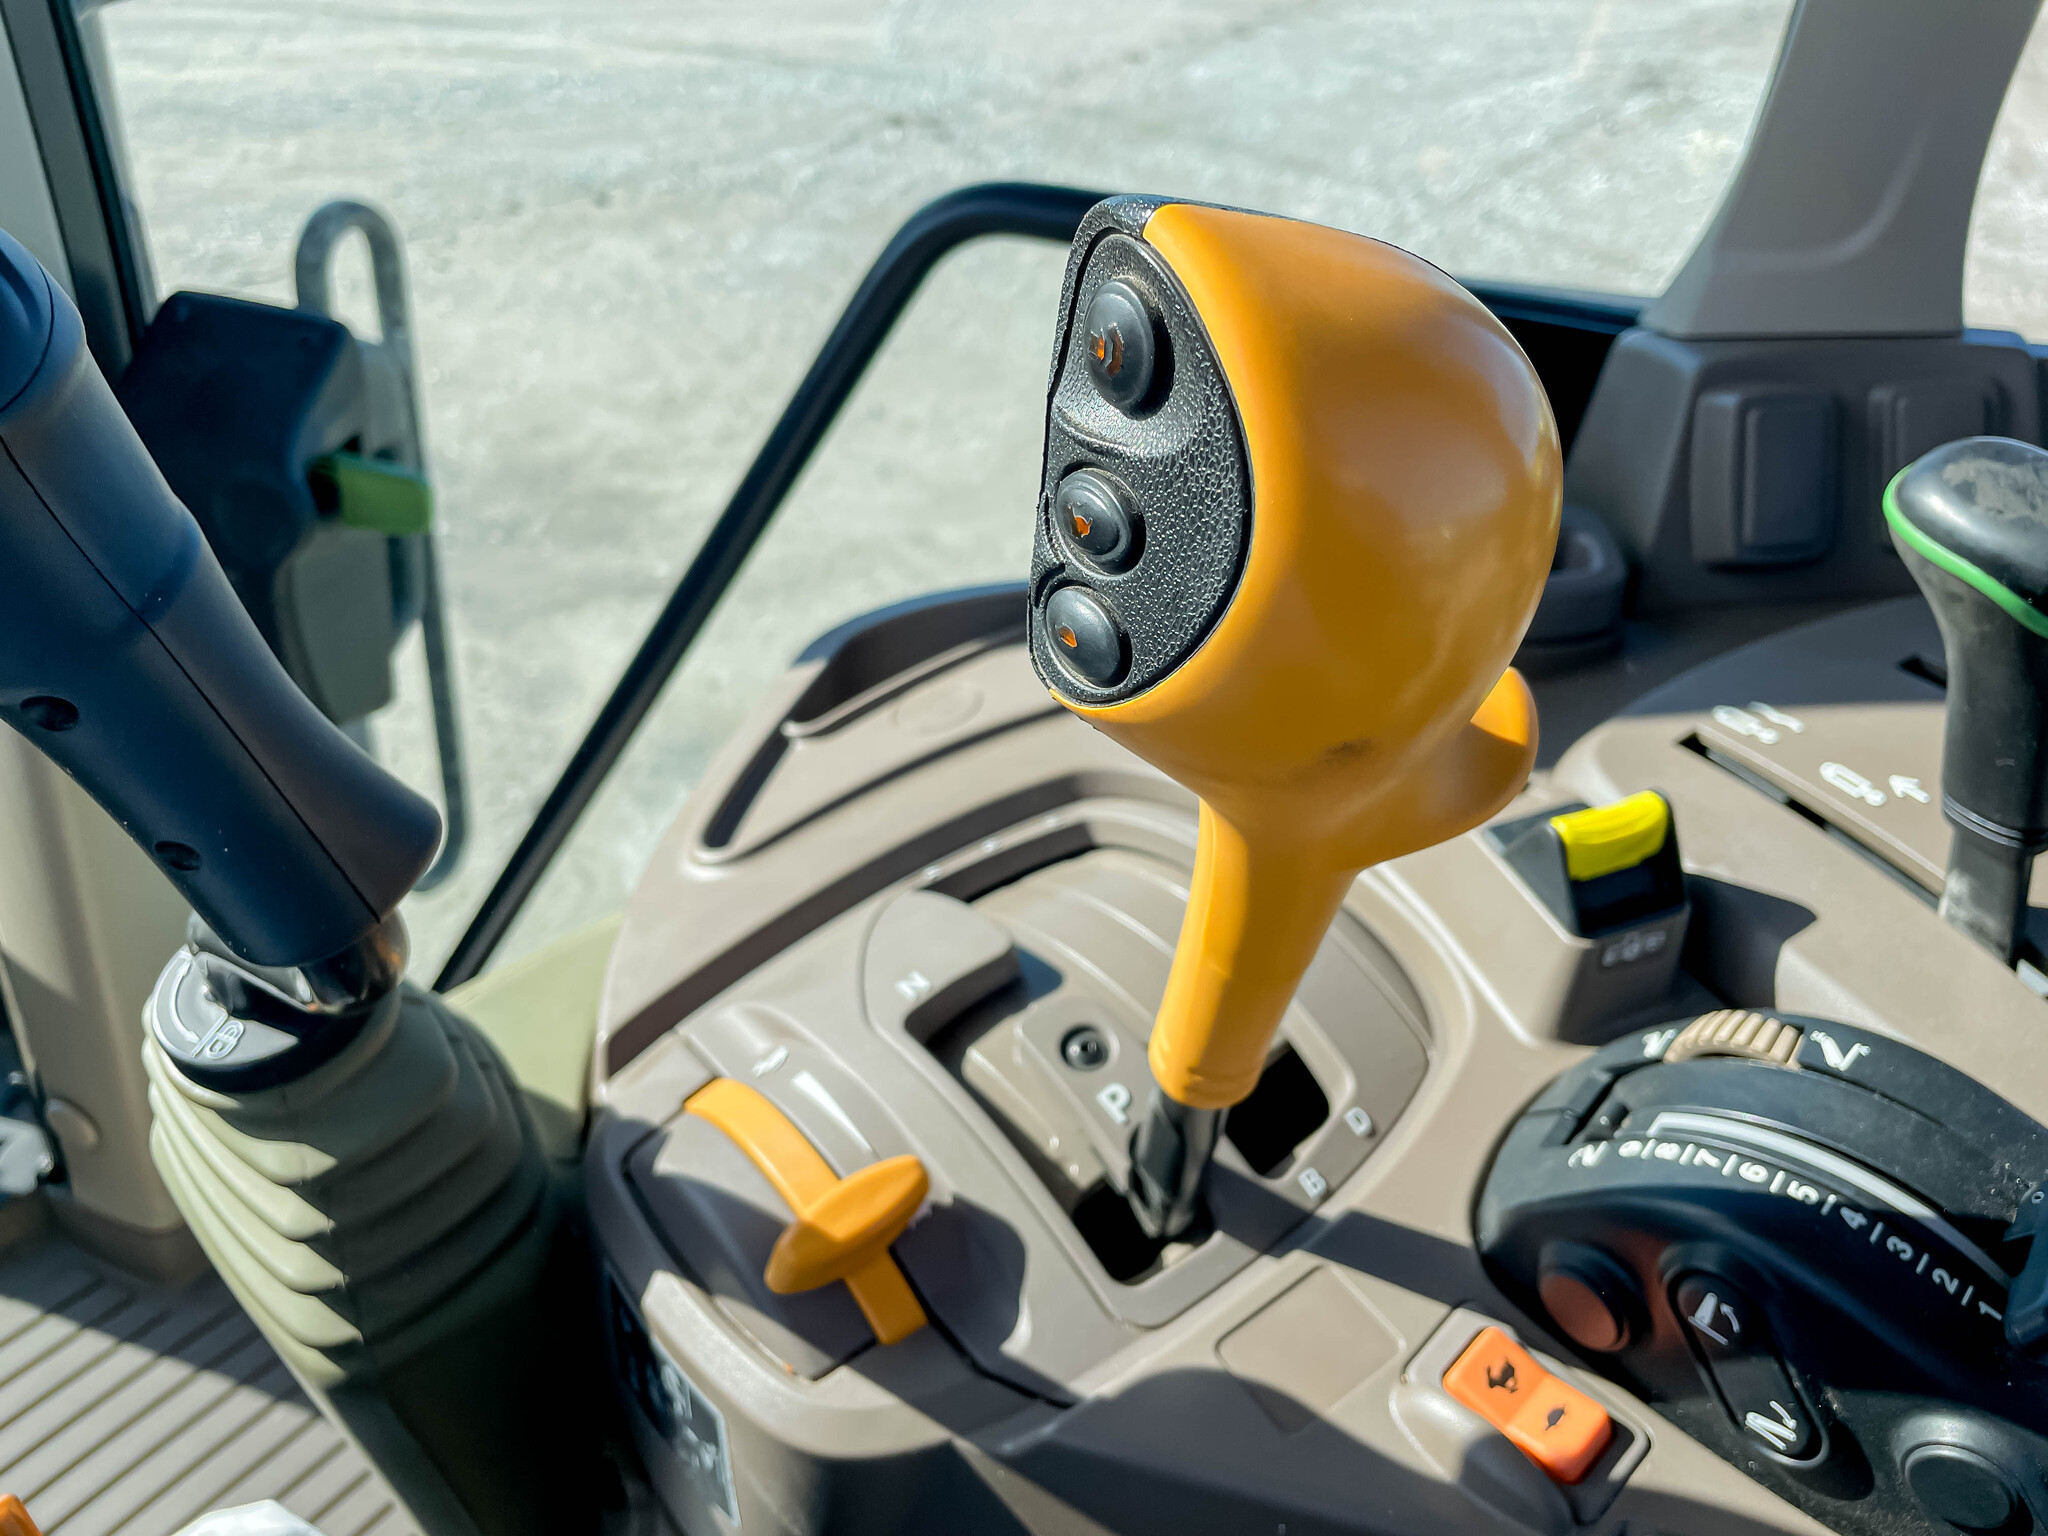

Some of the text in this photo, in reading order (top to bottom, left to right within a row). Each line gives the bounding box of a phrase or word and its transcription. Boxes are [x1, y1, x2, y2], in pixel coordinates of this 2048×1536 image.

[895, 970, 931, 1002] N
[1096, 1082, 1131, 1124] P
[1343, 1106, 1373, 1137] D
[1693, 1147, 1722, 1168] 7
[1738, 1161, 1769, 1183] 6
[1786, 1179, 1820, 1205] 5
[1839, 1205, 1869, 1231] 4
[1886, 1235, 1915, 1262] 3
[1931, 1267, 1960, 1296] 2
[1978, 1300, 2004, 1322] 1
